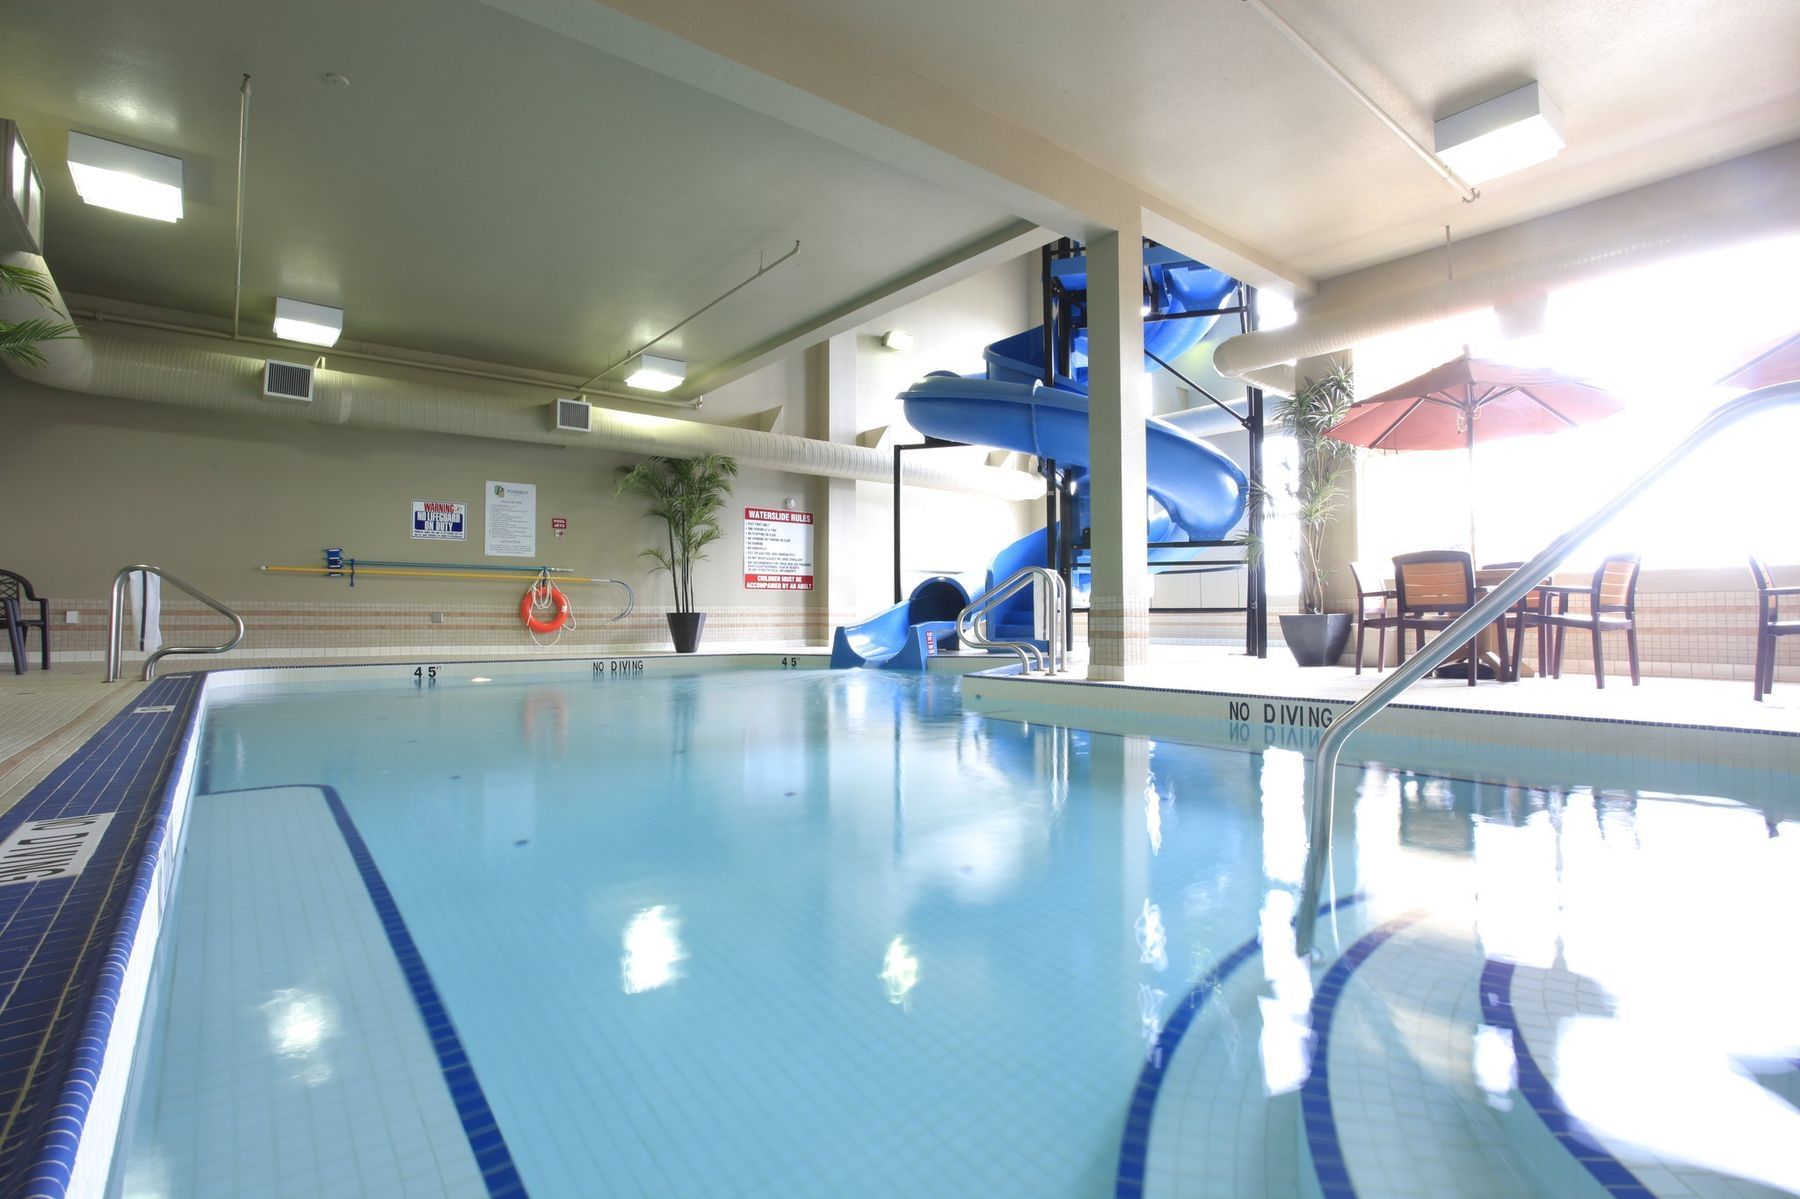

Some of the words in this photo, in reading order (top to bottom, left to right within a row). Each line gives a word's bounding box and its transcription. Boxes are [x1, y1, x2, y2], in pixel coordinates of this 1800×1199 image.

[424, 502, 454, 512] WARNING
[417, 511, 426, 521] NO
[427, 512, 460, 523] LIFEGUARD
[749, 510, 790, 521] WATERSLIDE
[790, 514, 811, 523] RULES
[425, 521, 434, 530] ON
[436, 522, 453, 531] DUTY
[593, 661, 604, 672] NO
[611, 660, 644, 671] DIVING
[1229, 701, 1250, 722] NO
[1264, 703, 1333, 729] DIVING
